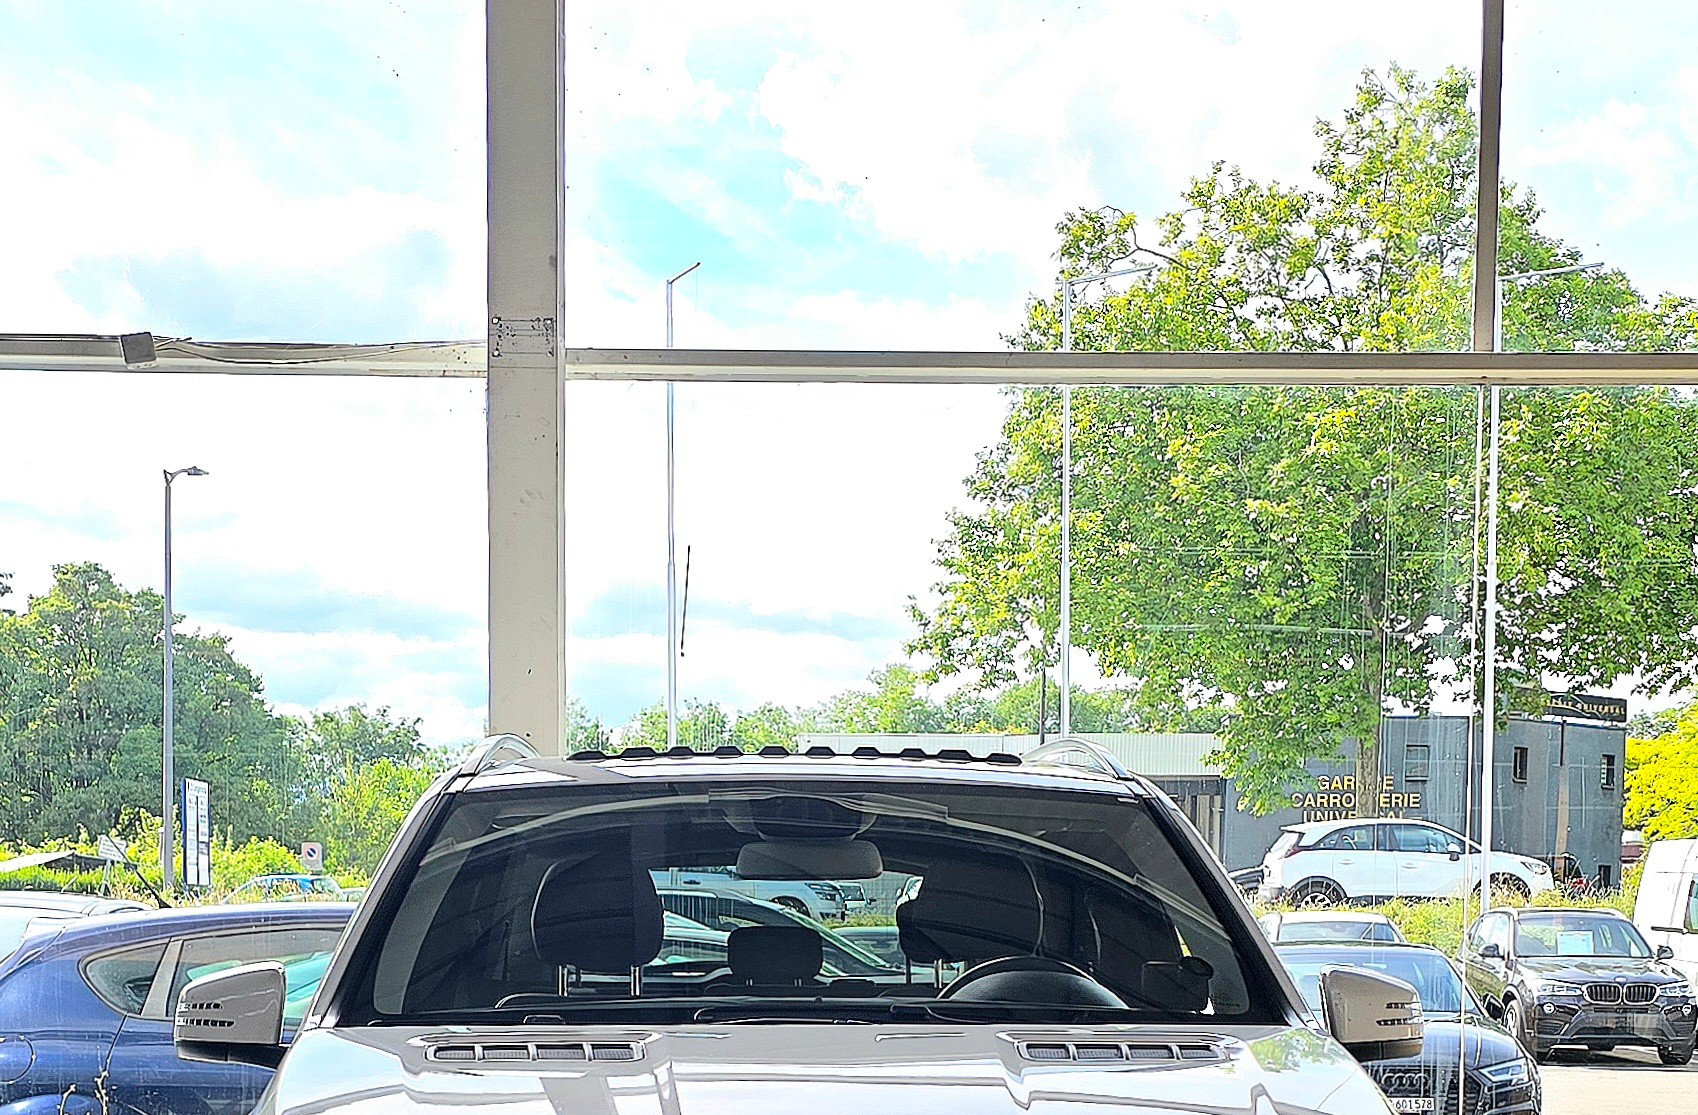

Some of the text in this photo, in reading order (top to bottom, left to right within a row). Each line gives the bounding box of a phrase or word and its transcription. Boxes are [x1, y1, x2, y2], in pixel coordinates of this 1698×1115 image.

[1317, 775, 1394, 790] GARE
[1291, 793, 1420, 808] CARROERIE
[1303, 810, 1405, 823] UNIVEAL
